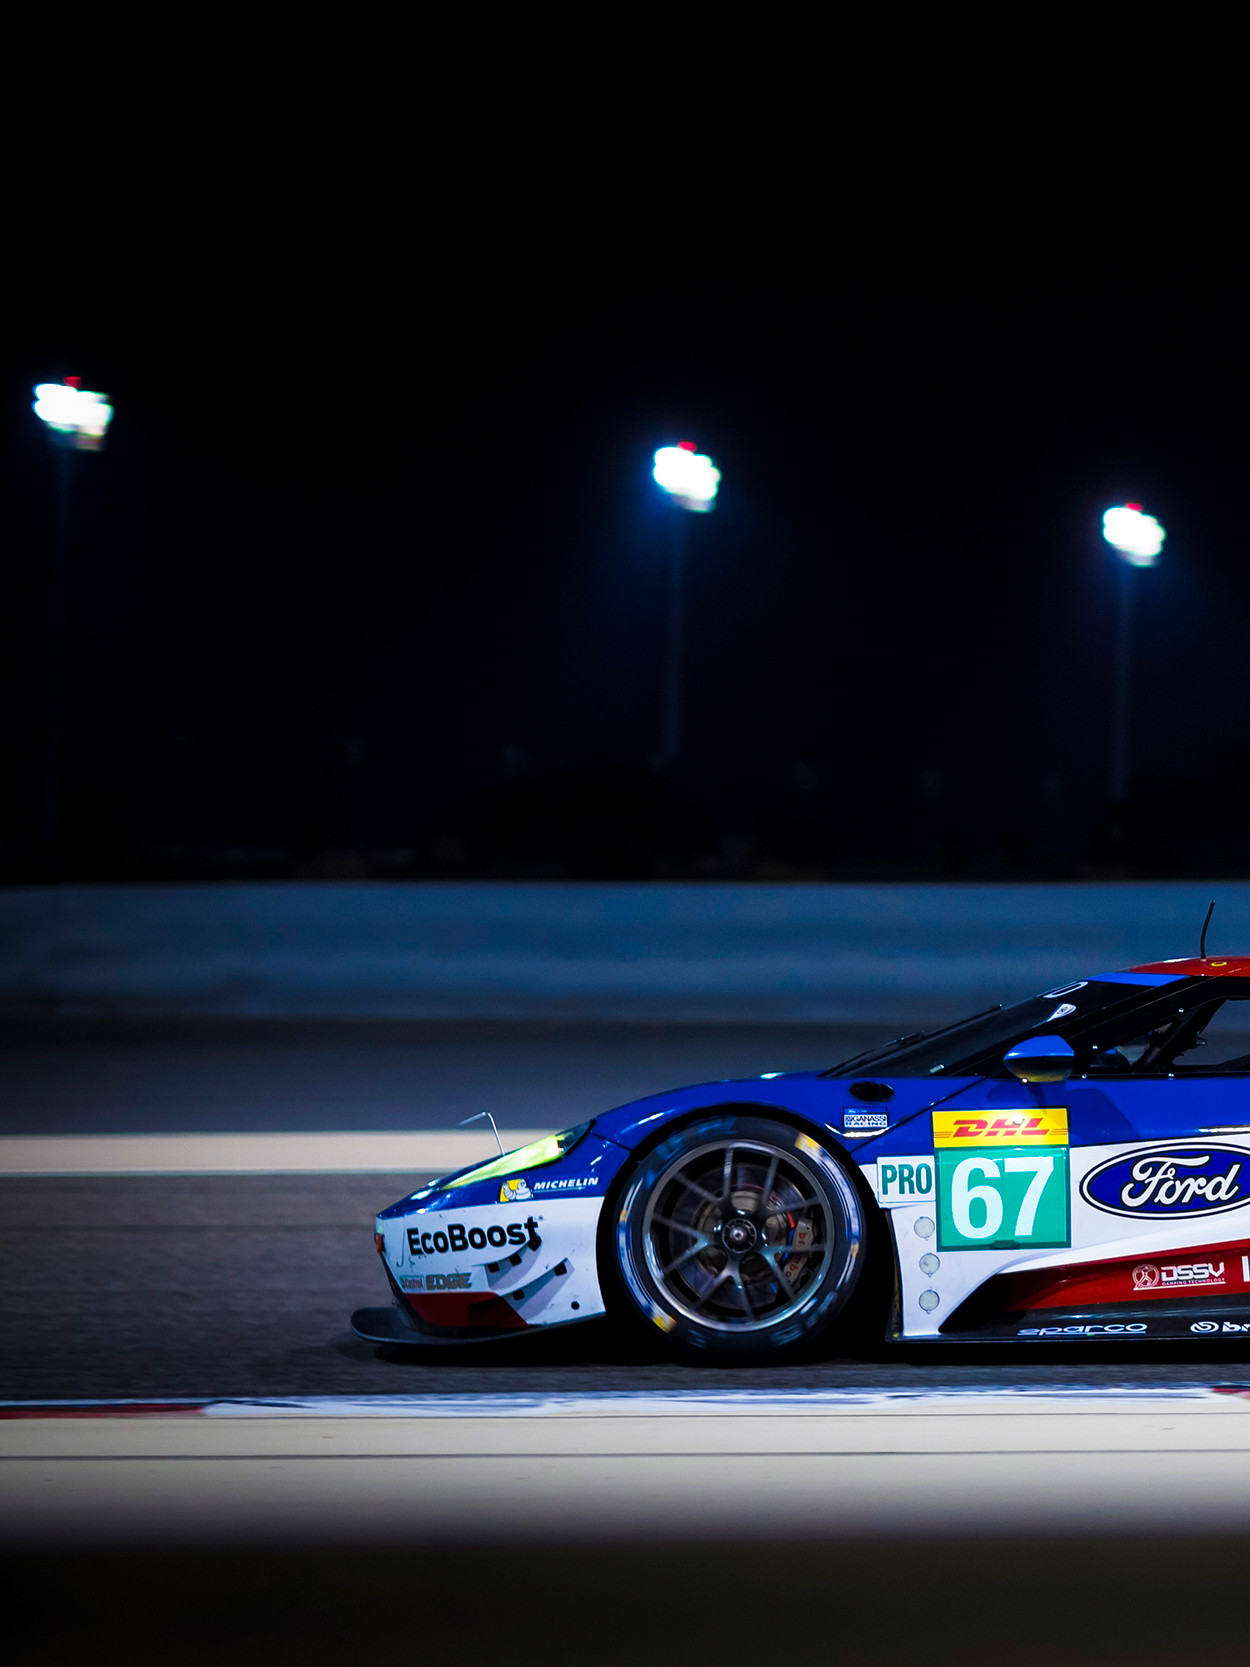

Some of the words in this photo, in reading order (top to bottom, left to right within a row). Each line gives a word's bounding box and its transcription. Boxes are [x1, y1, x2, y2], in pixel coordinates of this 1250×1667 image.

[952, 1117, 1050, 1138] DHL
[533, 1177, 599, 1190] MICHELIN
[881, 1163, 933, 1195] PRO
[1122, 1154, 1240, 1208] Ford
[951, 1156, 1054, 1240] 67
[407, 1216, 539, 1255] EcoBoost
[426, 1273, 472, 1290] EDGE
[1161, 1262, 1225, 1281] DSSV
[1018, 1322, 1148, 1336] sparco
